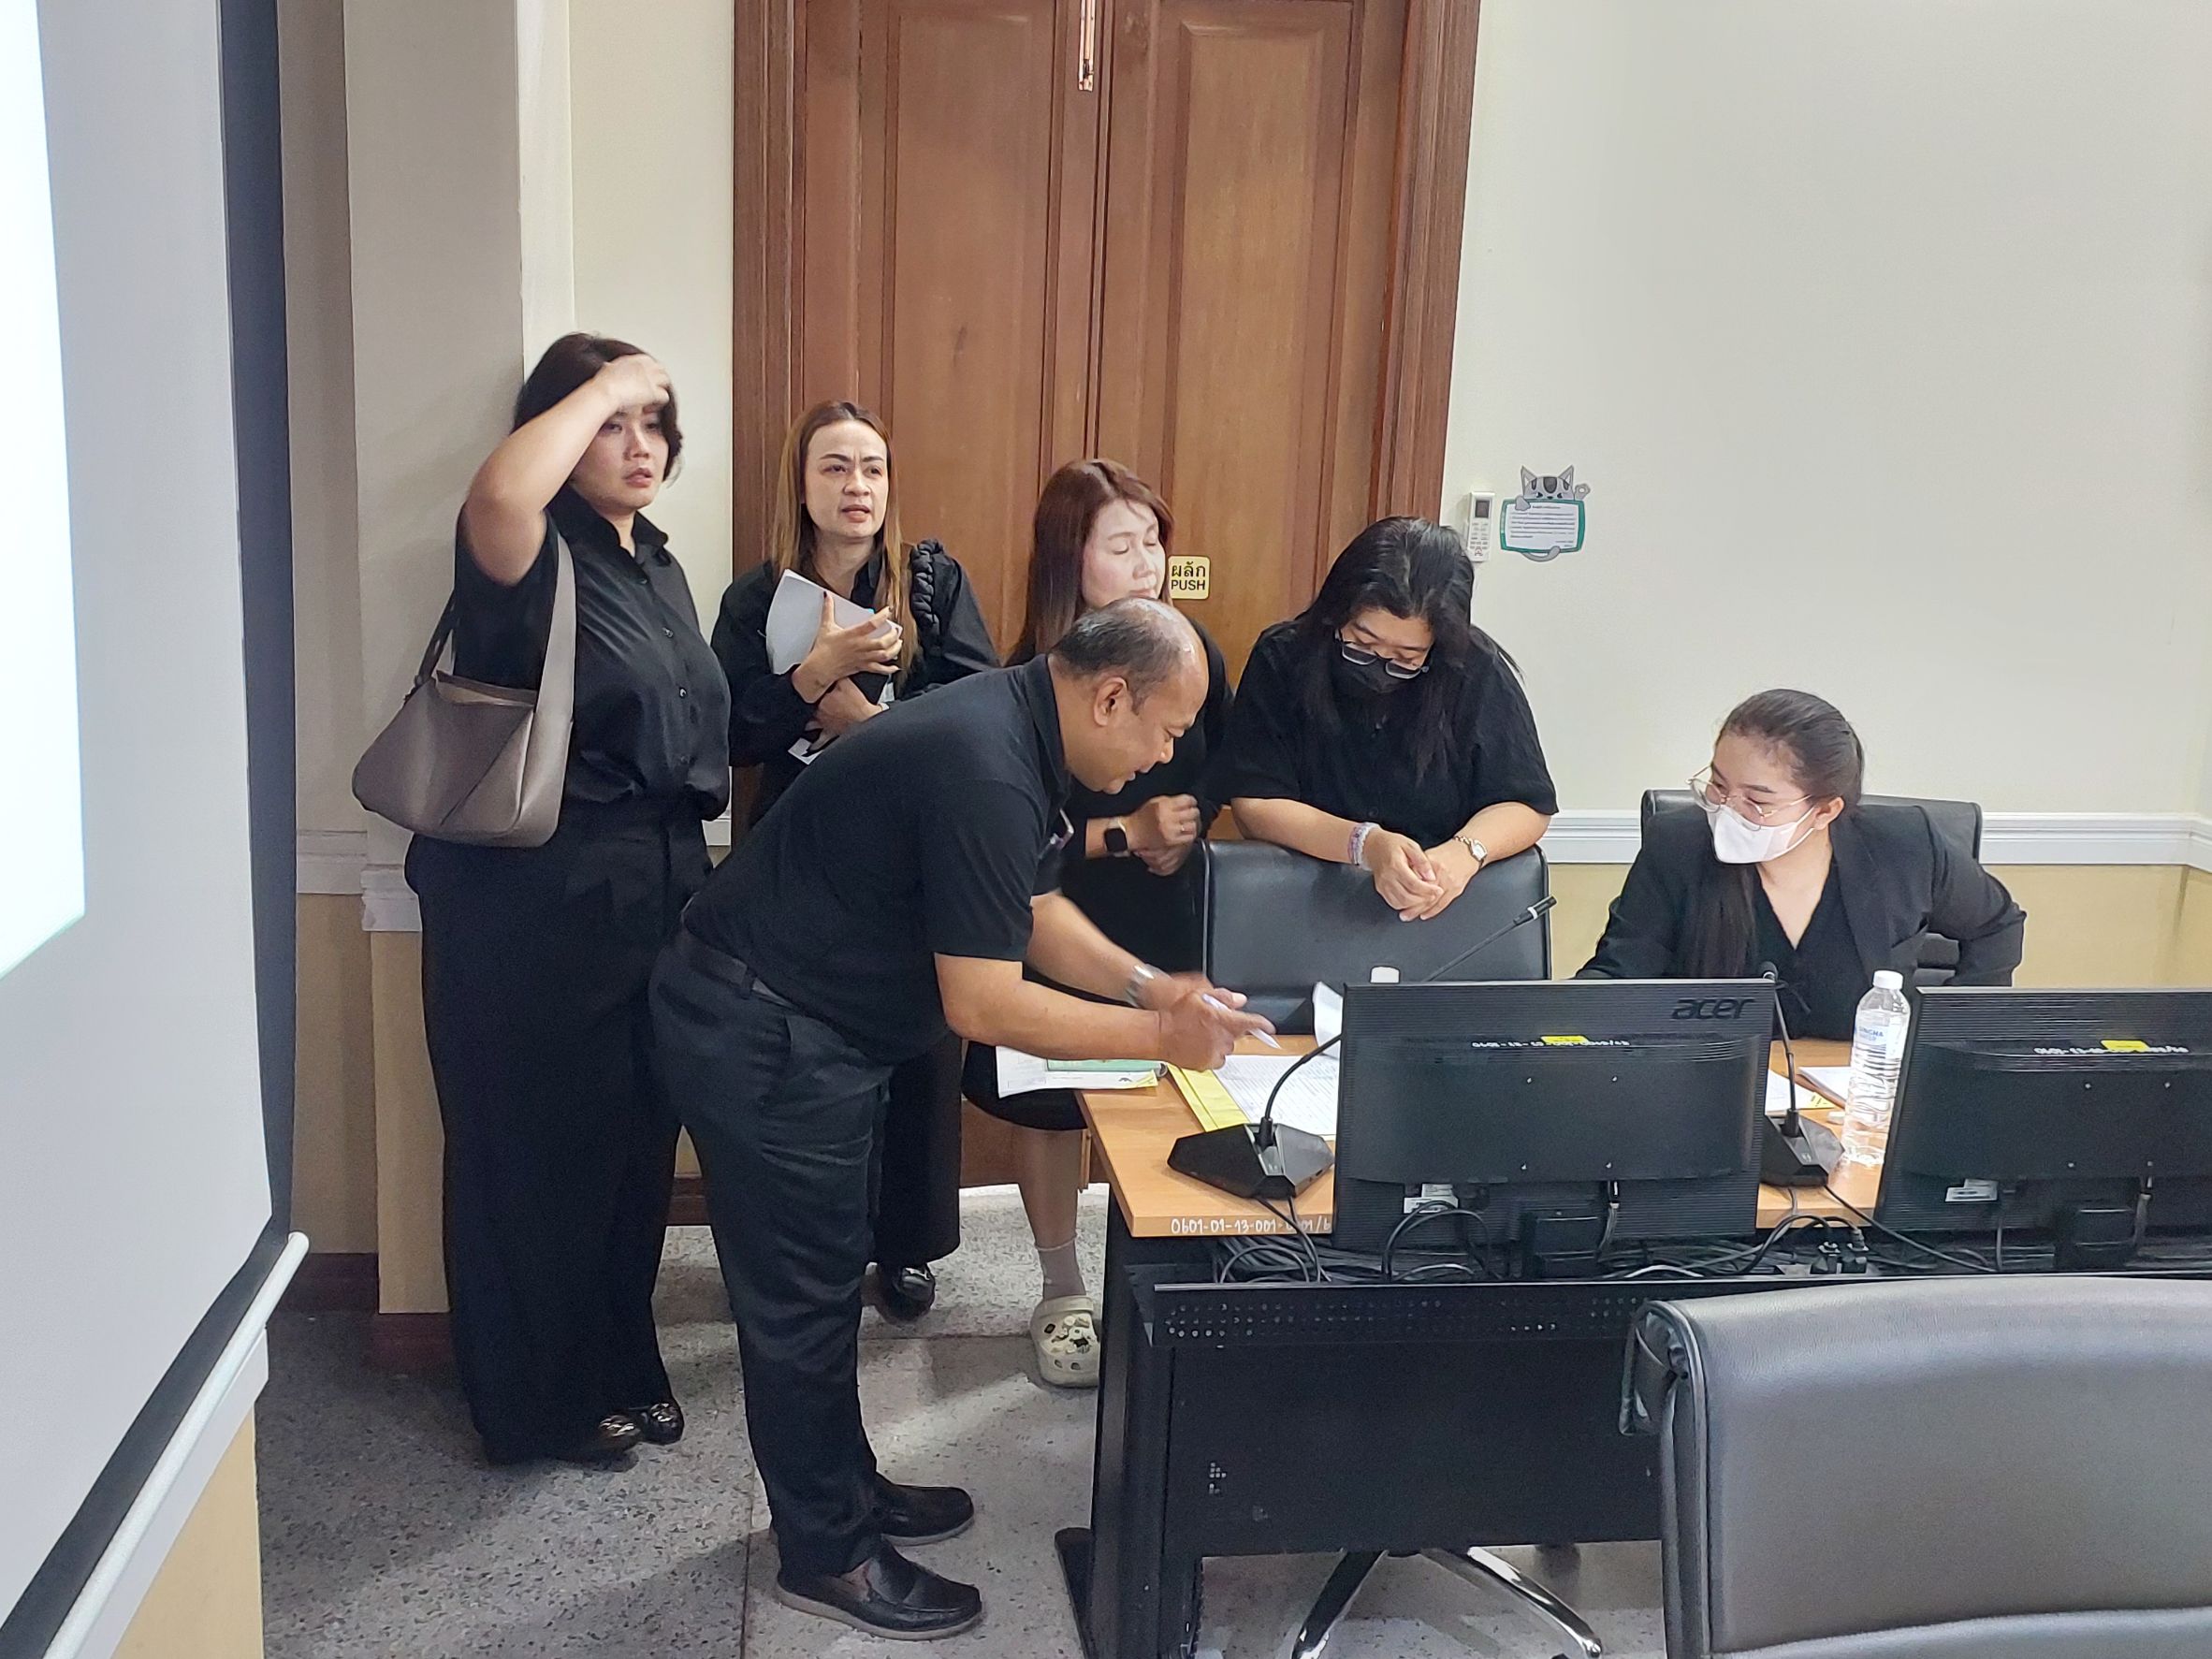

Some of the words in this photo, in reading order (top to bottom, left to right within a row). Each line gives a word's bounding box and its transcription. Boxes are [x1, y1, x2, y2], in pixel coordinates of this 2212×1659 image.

[1171, 561, 1206, 577] ผลัก
[1171, 579, 1206, 590] PUSH
[1671, 997, 1755, 1019] acer
